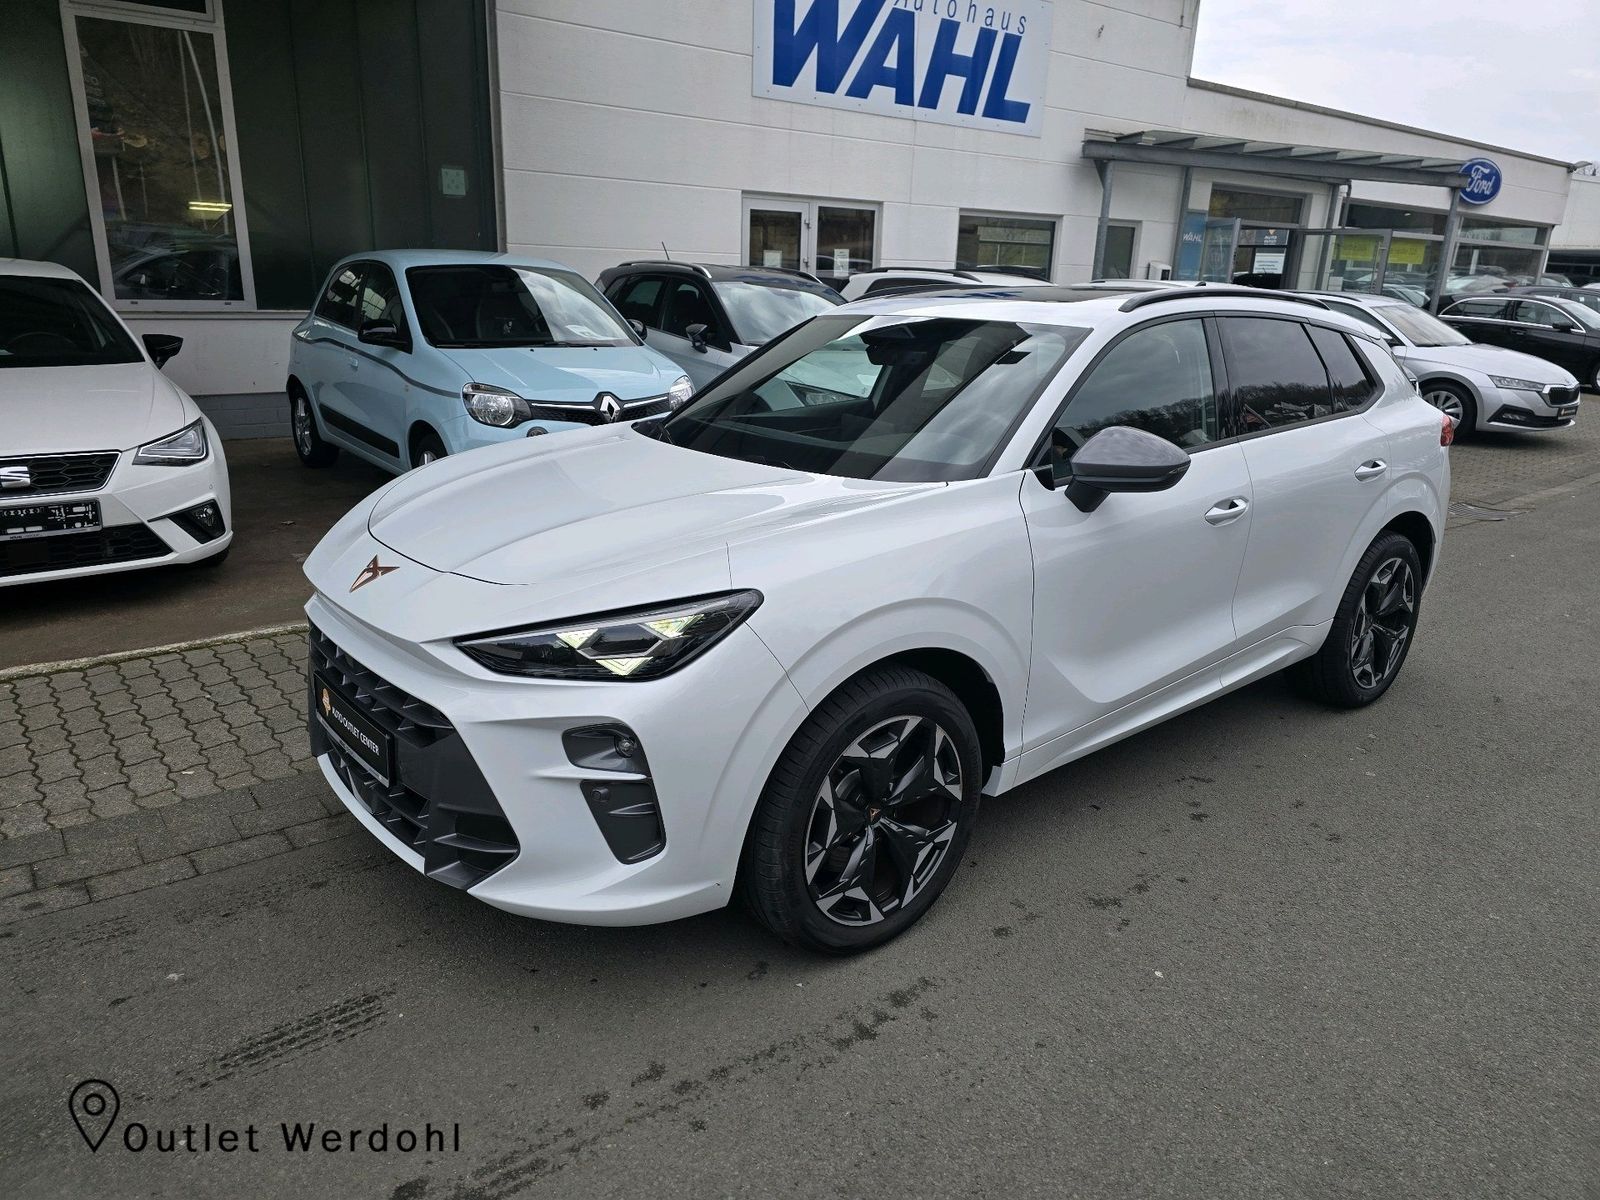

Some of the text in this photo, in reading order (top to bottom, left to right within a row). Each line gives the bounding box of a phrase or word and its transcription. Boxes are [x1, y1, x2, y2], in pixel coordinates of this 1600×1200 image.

[772, 0, 1031, 124] WAHL
[1465, 164, 1496, 195] Ford
[360, 732, 379, 755] CENTER
